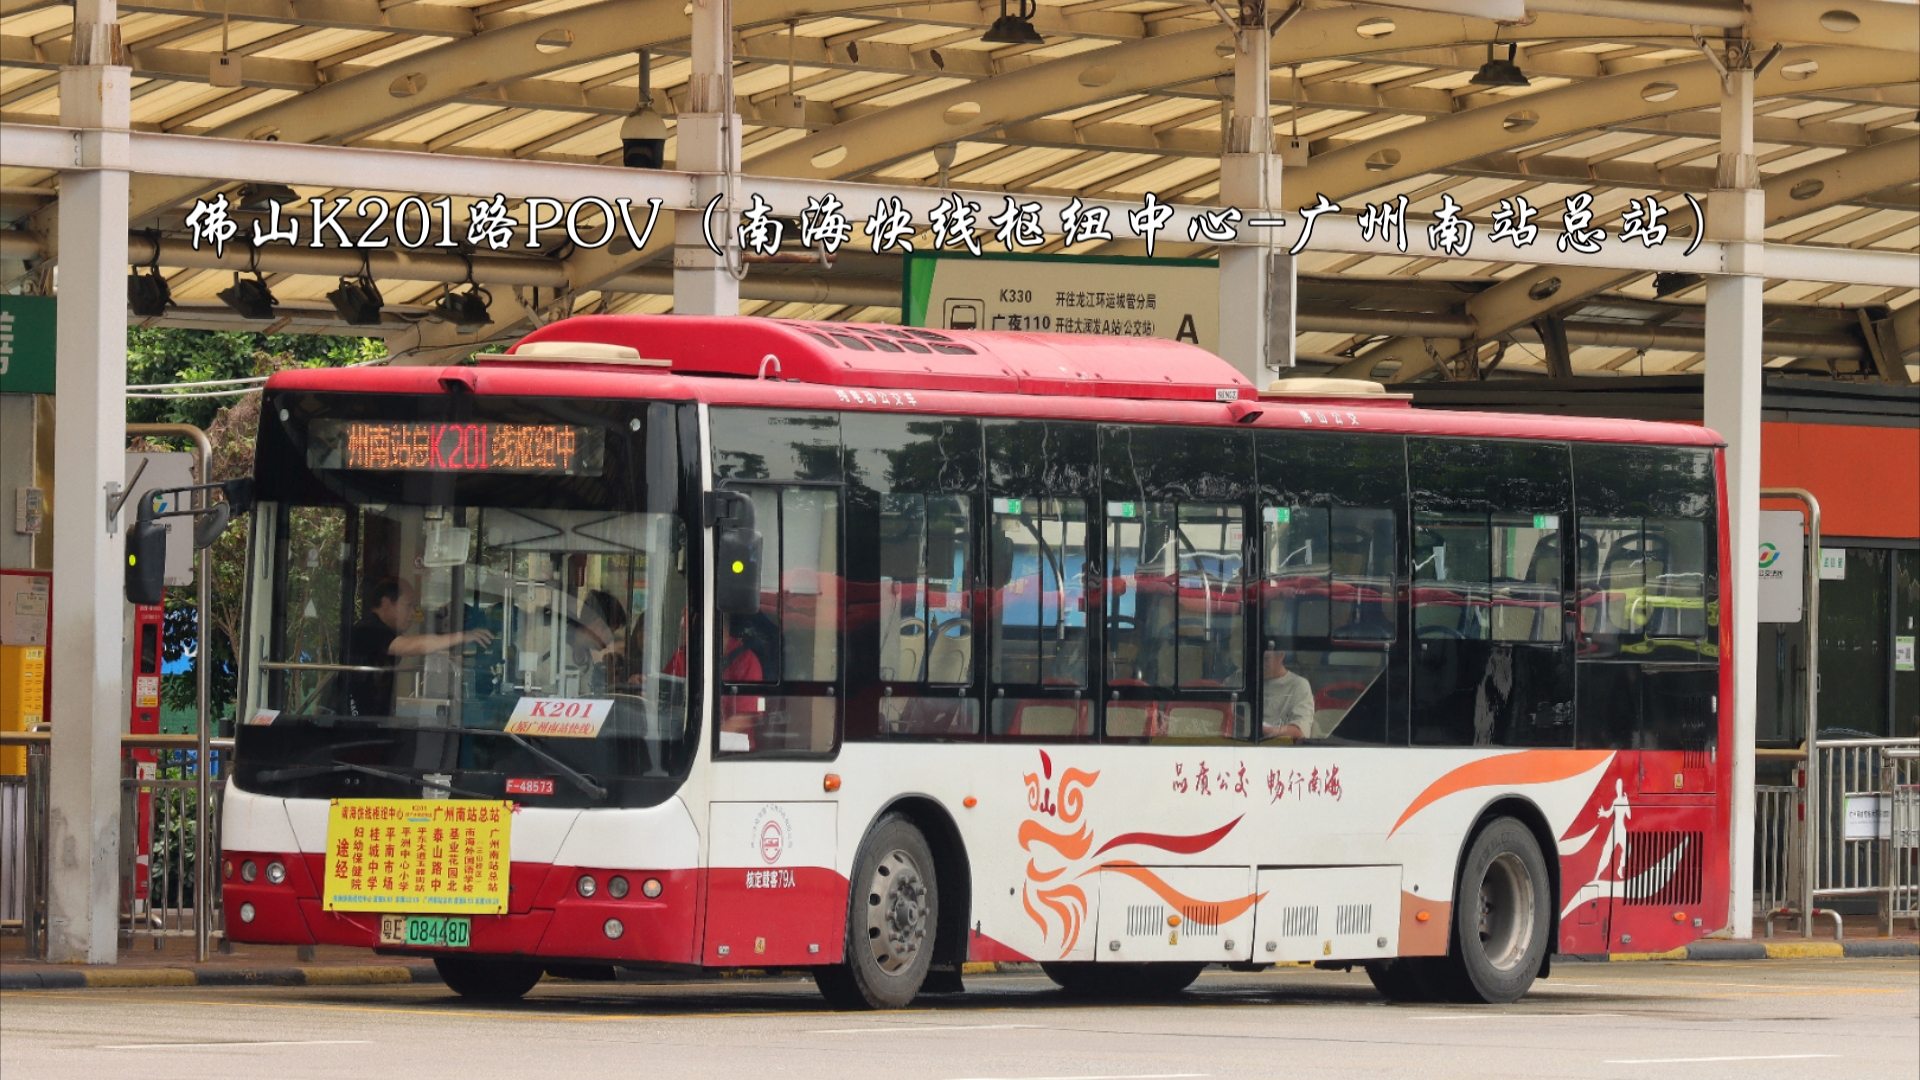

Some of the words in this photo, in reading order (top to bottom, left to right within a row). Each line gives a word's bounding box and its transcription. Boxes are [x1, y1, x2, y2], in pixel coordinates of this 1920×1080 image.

[1000, 289, 1032, 303] K330
[1056, 291, 1157, 310] 开往龙江环运城管分局
[991, 314, 1051, 331] 广夜110
[1175, 313, 1199, 345] A
[834, 388, 917, 407] 纯电动公交车
[529, 701, 594, 718] K201
[506, 781, 553, 793] F-48573
[1172, 760, 1249, 798] 品质公交
[1266, 763, 1343, 805] 畅行南海
[433, 806, 499, 823] 广州南站总站
[334, 838, 349, 879] 途经
[351, 826, 365, 890] 妇幼保健院
[367, 827, 380, 891] 桂城中学
[382, 827, 396, 891] 平南市场
[398, 827, 411, 892] 平洲中心小学
[430, 828, 443, 892] 泰山路中
[447, 828, 459, 892] 基业花园北
[463, 828, 475, 892] 南海外国语学校
[487, 828, 499, 892] 广州南站总站
[746, 870, 796, 889] 核定载客79人
[382, 919, 402, 940] 粤E
[409, 920, 468, 943] 08448D
